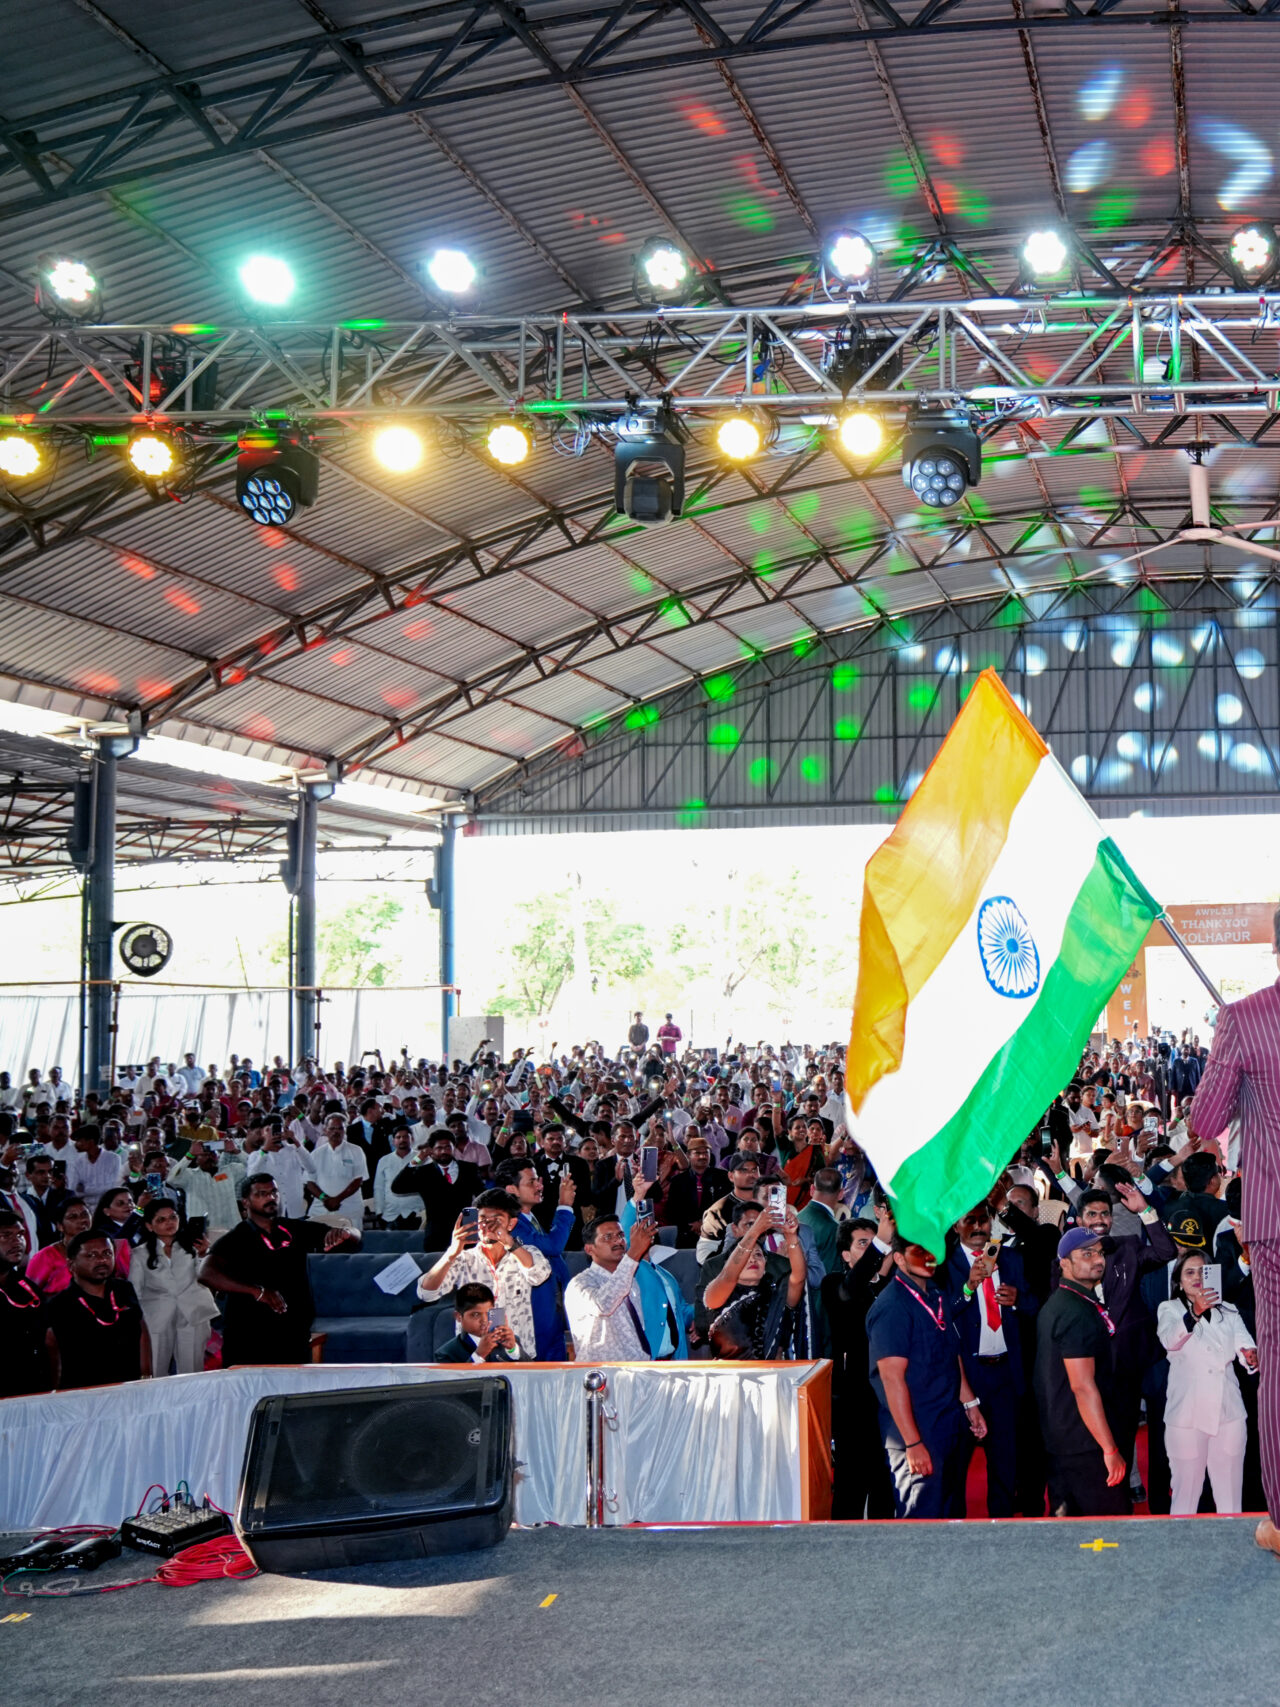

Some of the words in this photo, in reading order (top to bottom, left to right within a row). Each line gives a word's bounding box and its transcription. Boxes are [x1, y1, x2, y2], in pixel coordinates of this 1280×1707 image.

[1181, 919, 1223, 929] THANK
[1224, 918, 1249, 928] YOU
[1179, 931, 1251, 944] KOLHAPUR
